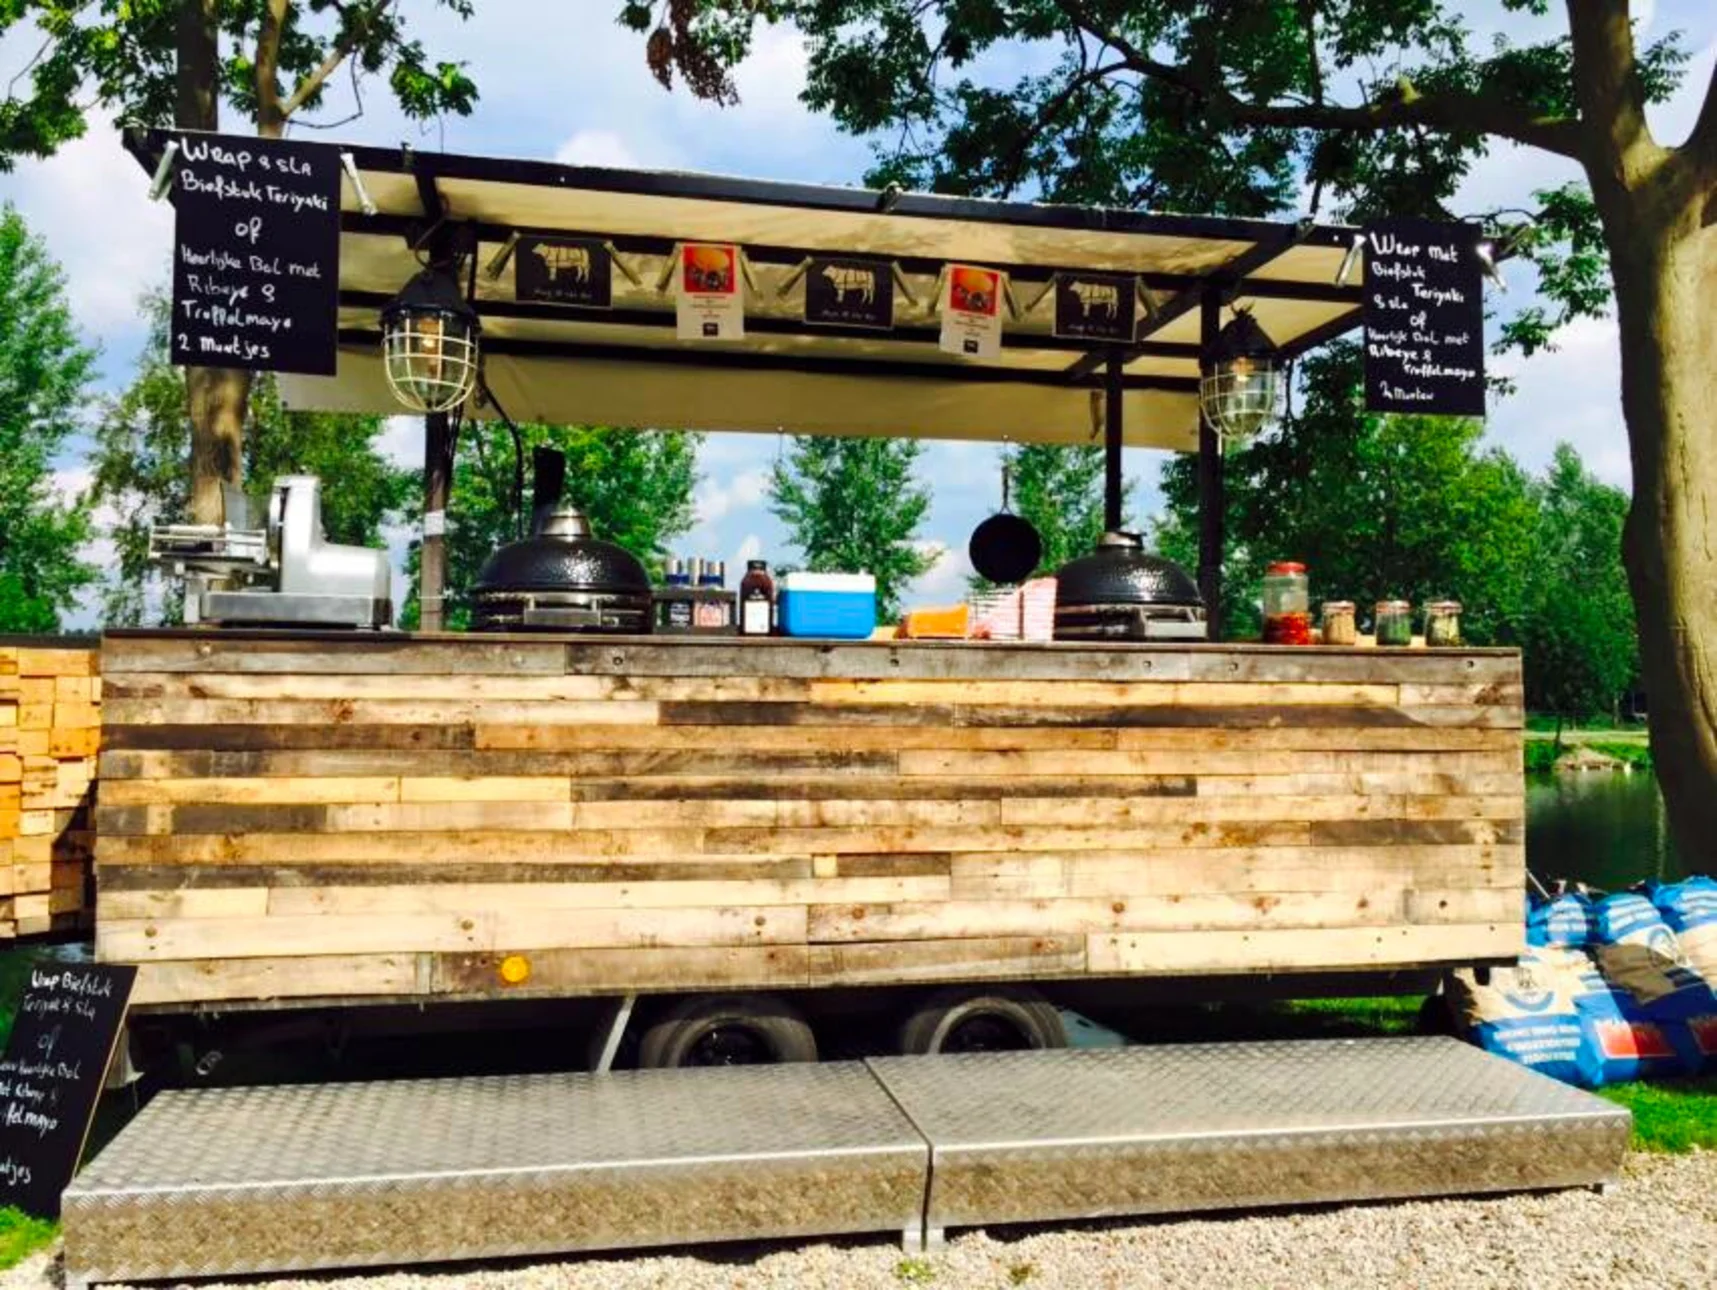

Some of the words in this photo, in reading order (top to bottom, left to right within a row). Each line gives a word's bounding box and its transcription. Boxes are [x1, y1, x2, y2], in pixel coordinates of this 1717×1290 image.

[265, 185, 328, 212] Teriyaki
[235, 216, 262, 244] of
[187, 274, 249, 306] Ribeye
[1410, 311, 1427, 330] of
[178, 334, 191, 350] 2
